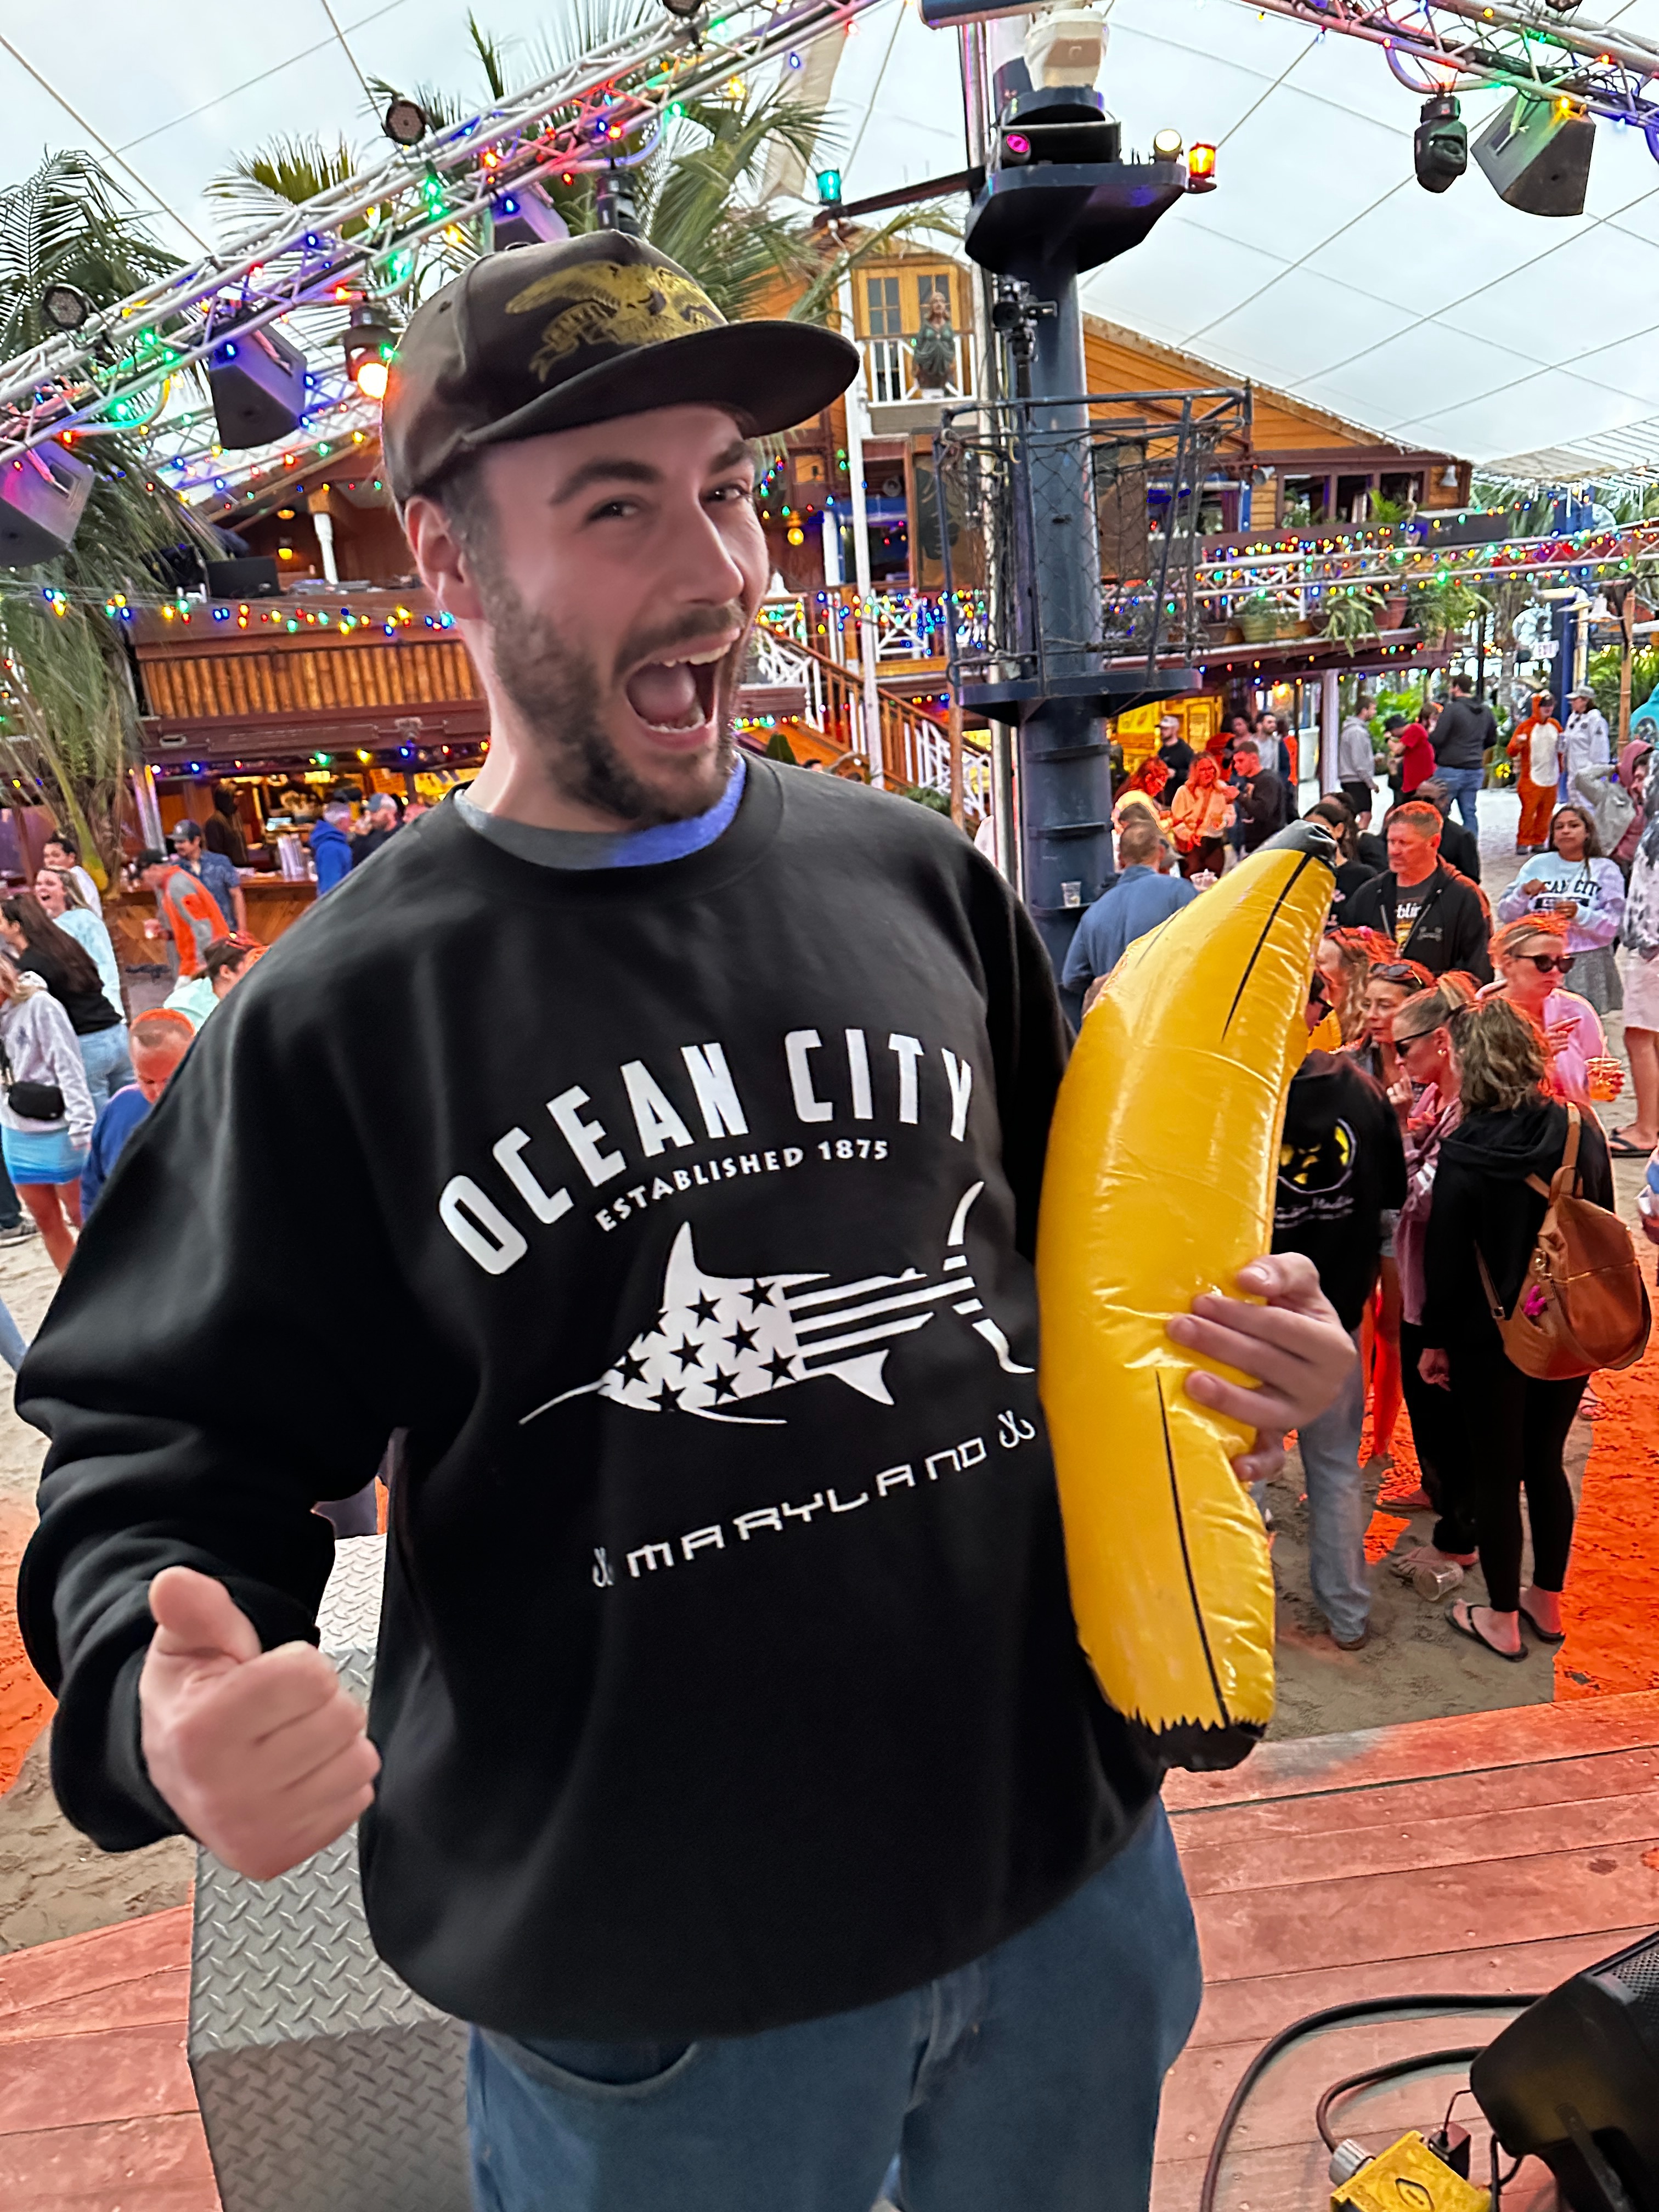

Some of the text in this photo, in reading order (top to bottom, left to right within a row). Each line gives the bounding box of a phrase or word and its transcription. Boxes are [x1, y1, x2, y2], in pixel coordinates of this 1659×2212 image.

[439, 1028, 973, 1276] OCEAN CITY
[595, 1138, 888, 1232] ESTABLISHED 1875
[626, 1437, 988, 1578] MARYLAND
